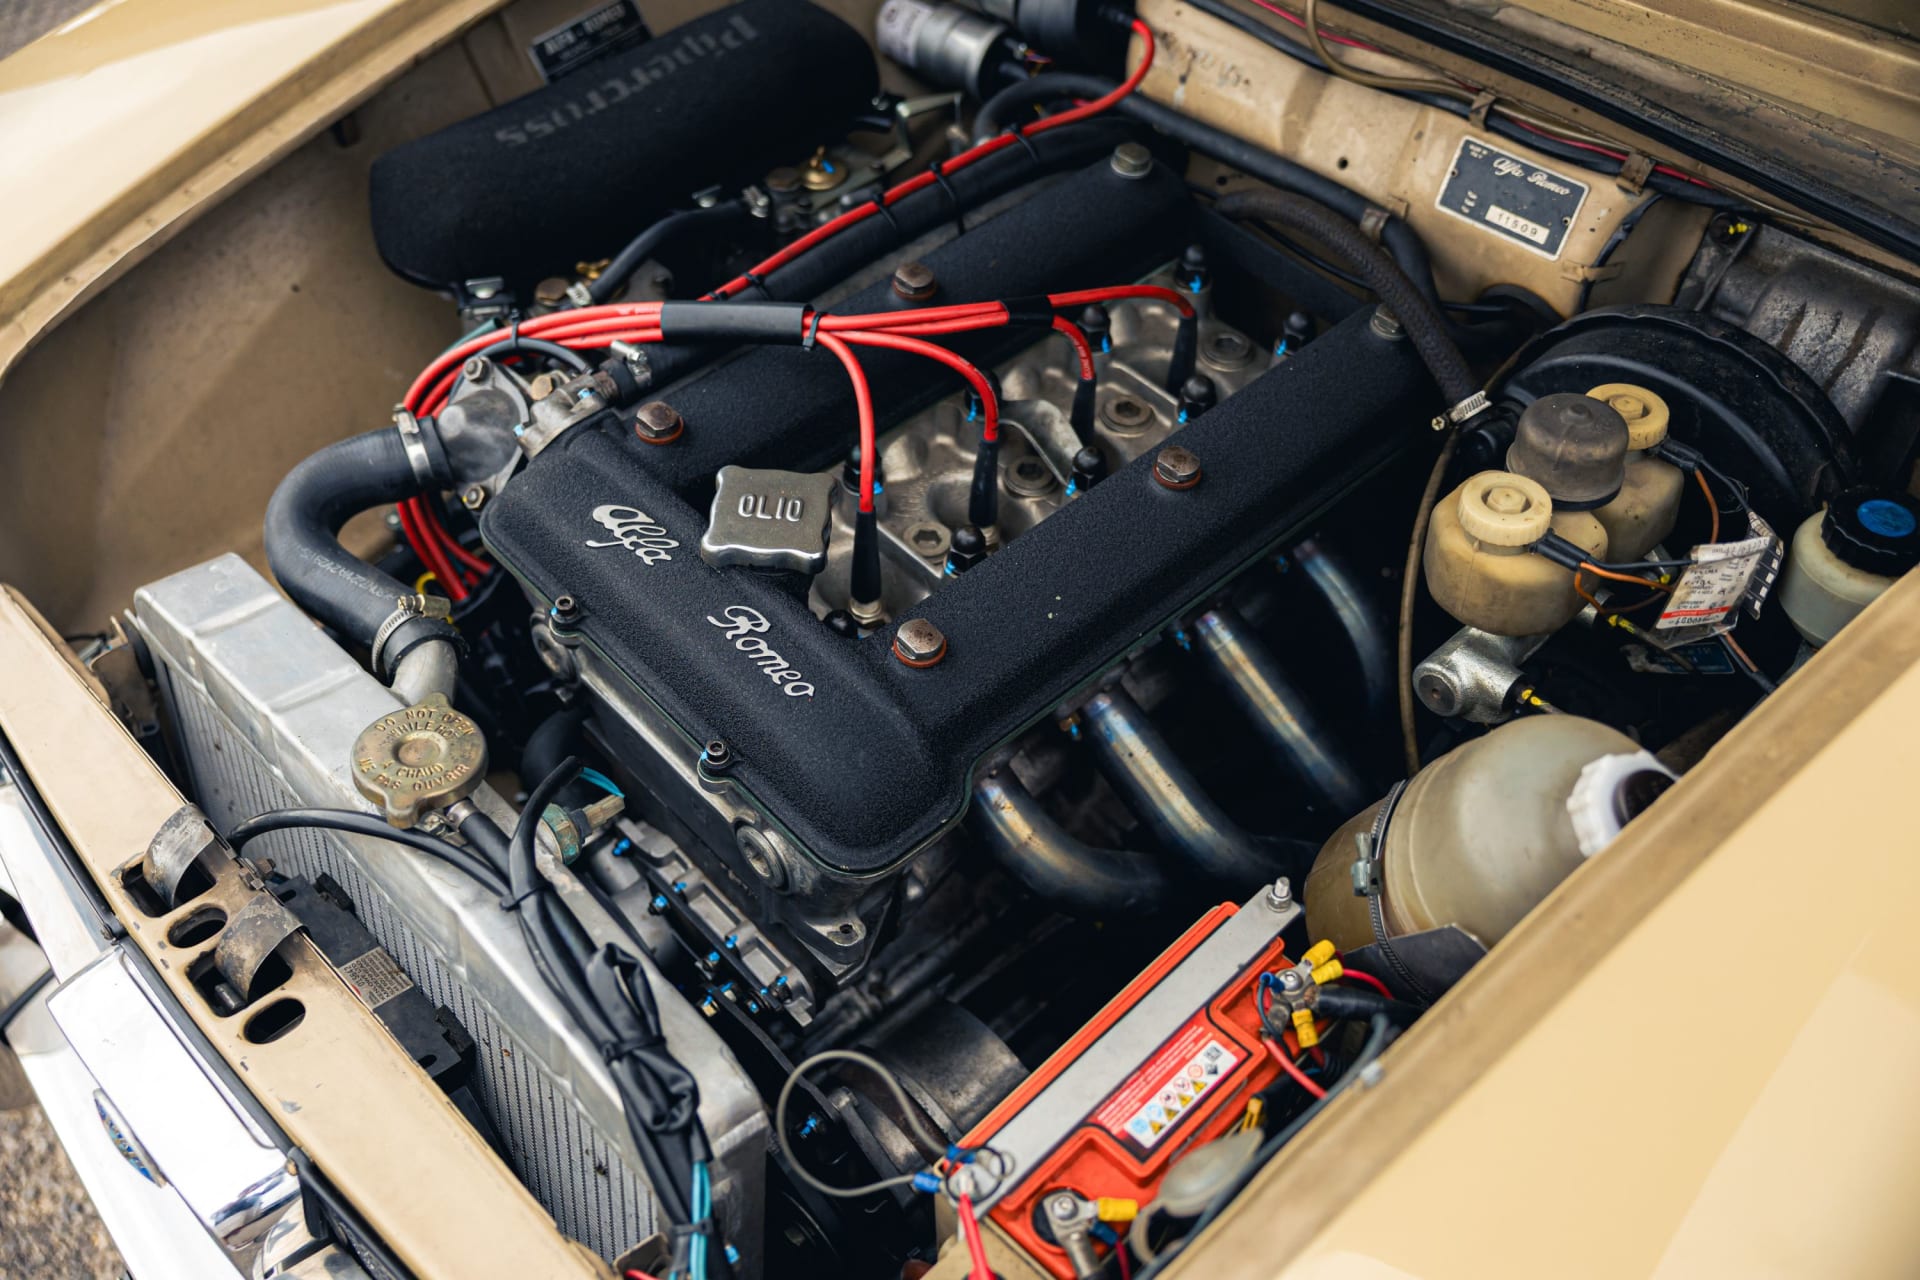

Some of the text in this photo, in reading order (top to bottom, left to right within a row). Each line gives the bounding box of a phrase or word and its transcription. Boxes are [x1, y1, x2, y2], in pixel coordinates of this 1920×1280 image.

[1492, 157, 1571, 196] Alfa Romeo
[1496, 212, 1538, 236] 11509
[738, 494, 803, 522] OLIO
[585, 504, 680, 566] Alfa
[707, 606, 815, 699] Romeo
[375, 708, 476, 736] DO NOT OPEN
[386, 721, 435, 738] WHILE
[359, 757, 470, 791] NE PAS OUVRIR
[396, 763, 444, 778] CHAUD
